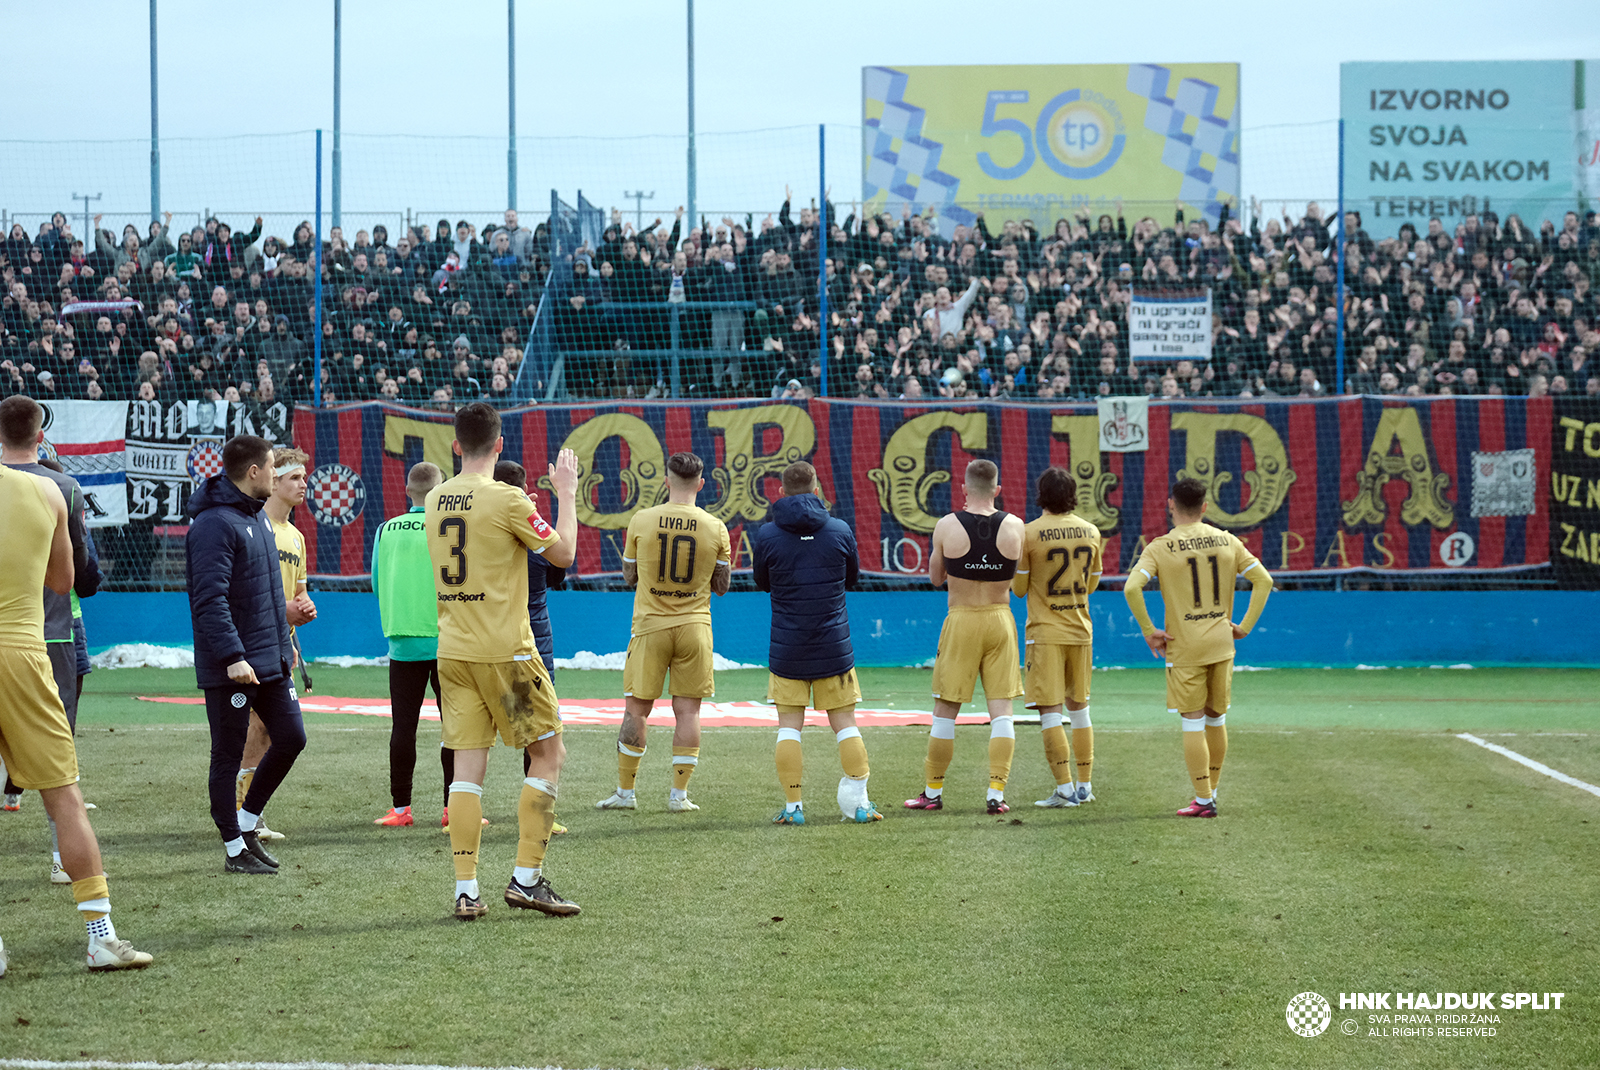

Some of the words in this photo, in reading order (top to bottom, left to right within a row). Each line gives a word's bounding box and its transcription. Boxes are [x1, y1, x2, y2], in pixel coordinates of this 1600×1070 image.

[1370, 89, 1510, 110] IZVORNO
[976, 88, 1126, 180] 50
[1062, 117, 1100, 151] tp
[1369, 125, 1467, 146] SVOJA
[1369, 161, 1413, 181] NA
[1422, 160, 1550, 181] SVAKOM
[132, 453, 178, 471] WHITE
[310, 464, 359, 486] HAJDUK
[437, 490, 474, 511] PRPIĆ
[314, 508, 355, 527] SPLIT
[387, 519, 426, 532] macr
[659, 516, 697, 531] LIVAJA
[437, 514, 468, 586] 3
[880, 536, 926, 573] 10.
[1166, 541, 1176, 553] Y.
[657, 532, 697, 584] 10
[964, 562, 1003, 570] CATAPULT
[1046, 545, 1093, 597] 23
[1186, 554, 1221, 609] 11
[437, 591, 486, 602] SuperSport
[649, 587, 698, 599] SuperSport
